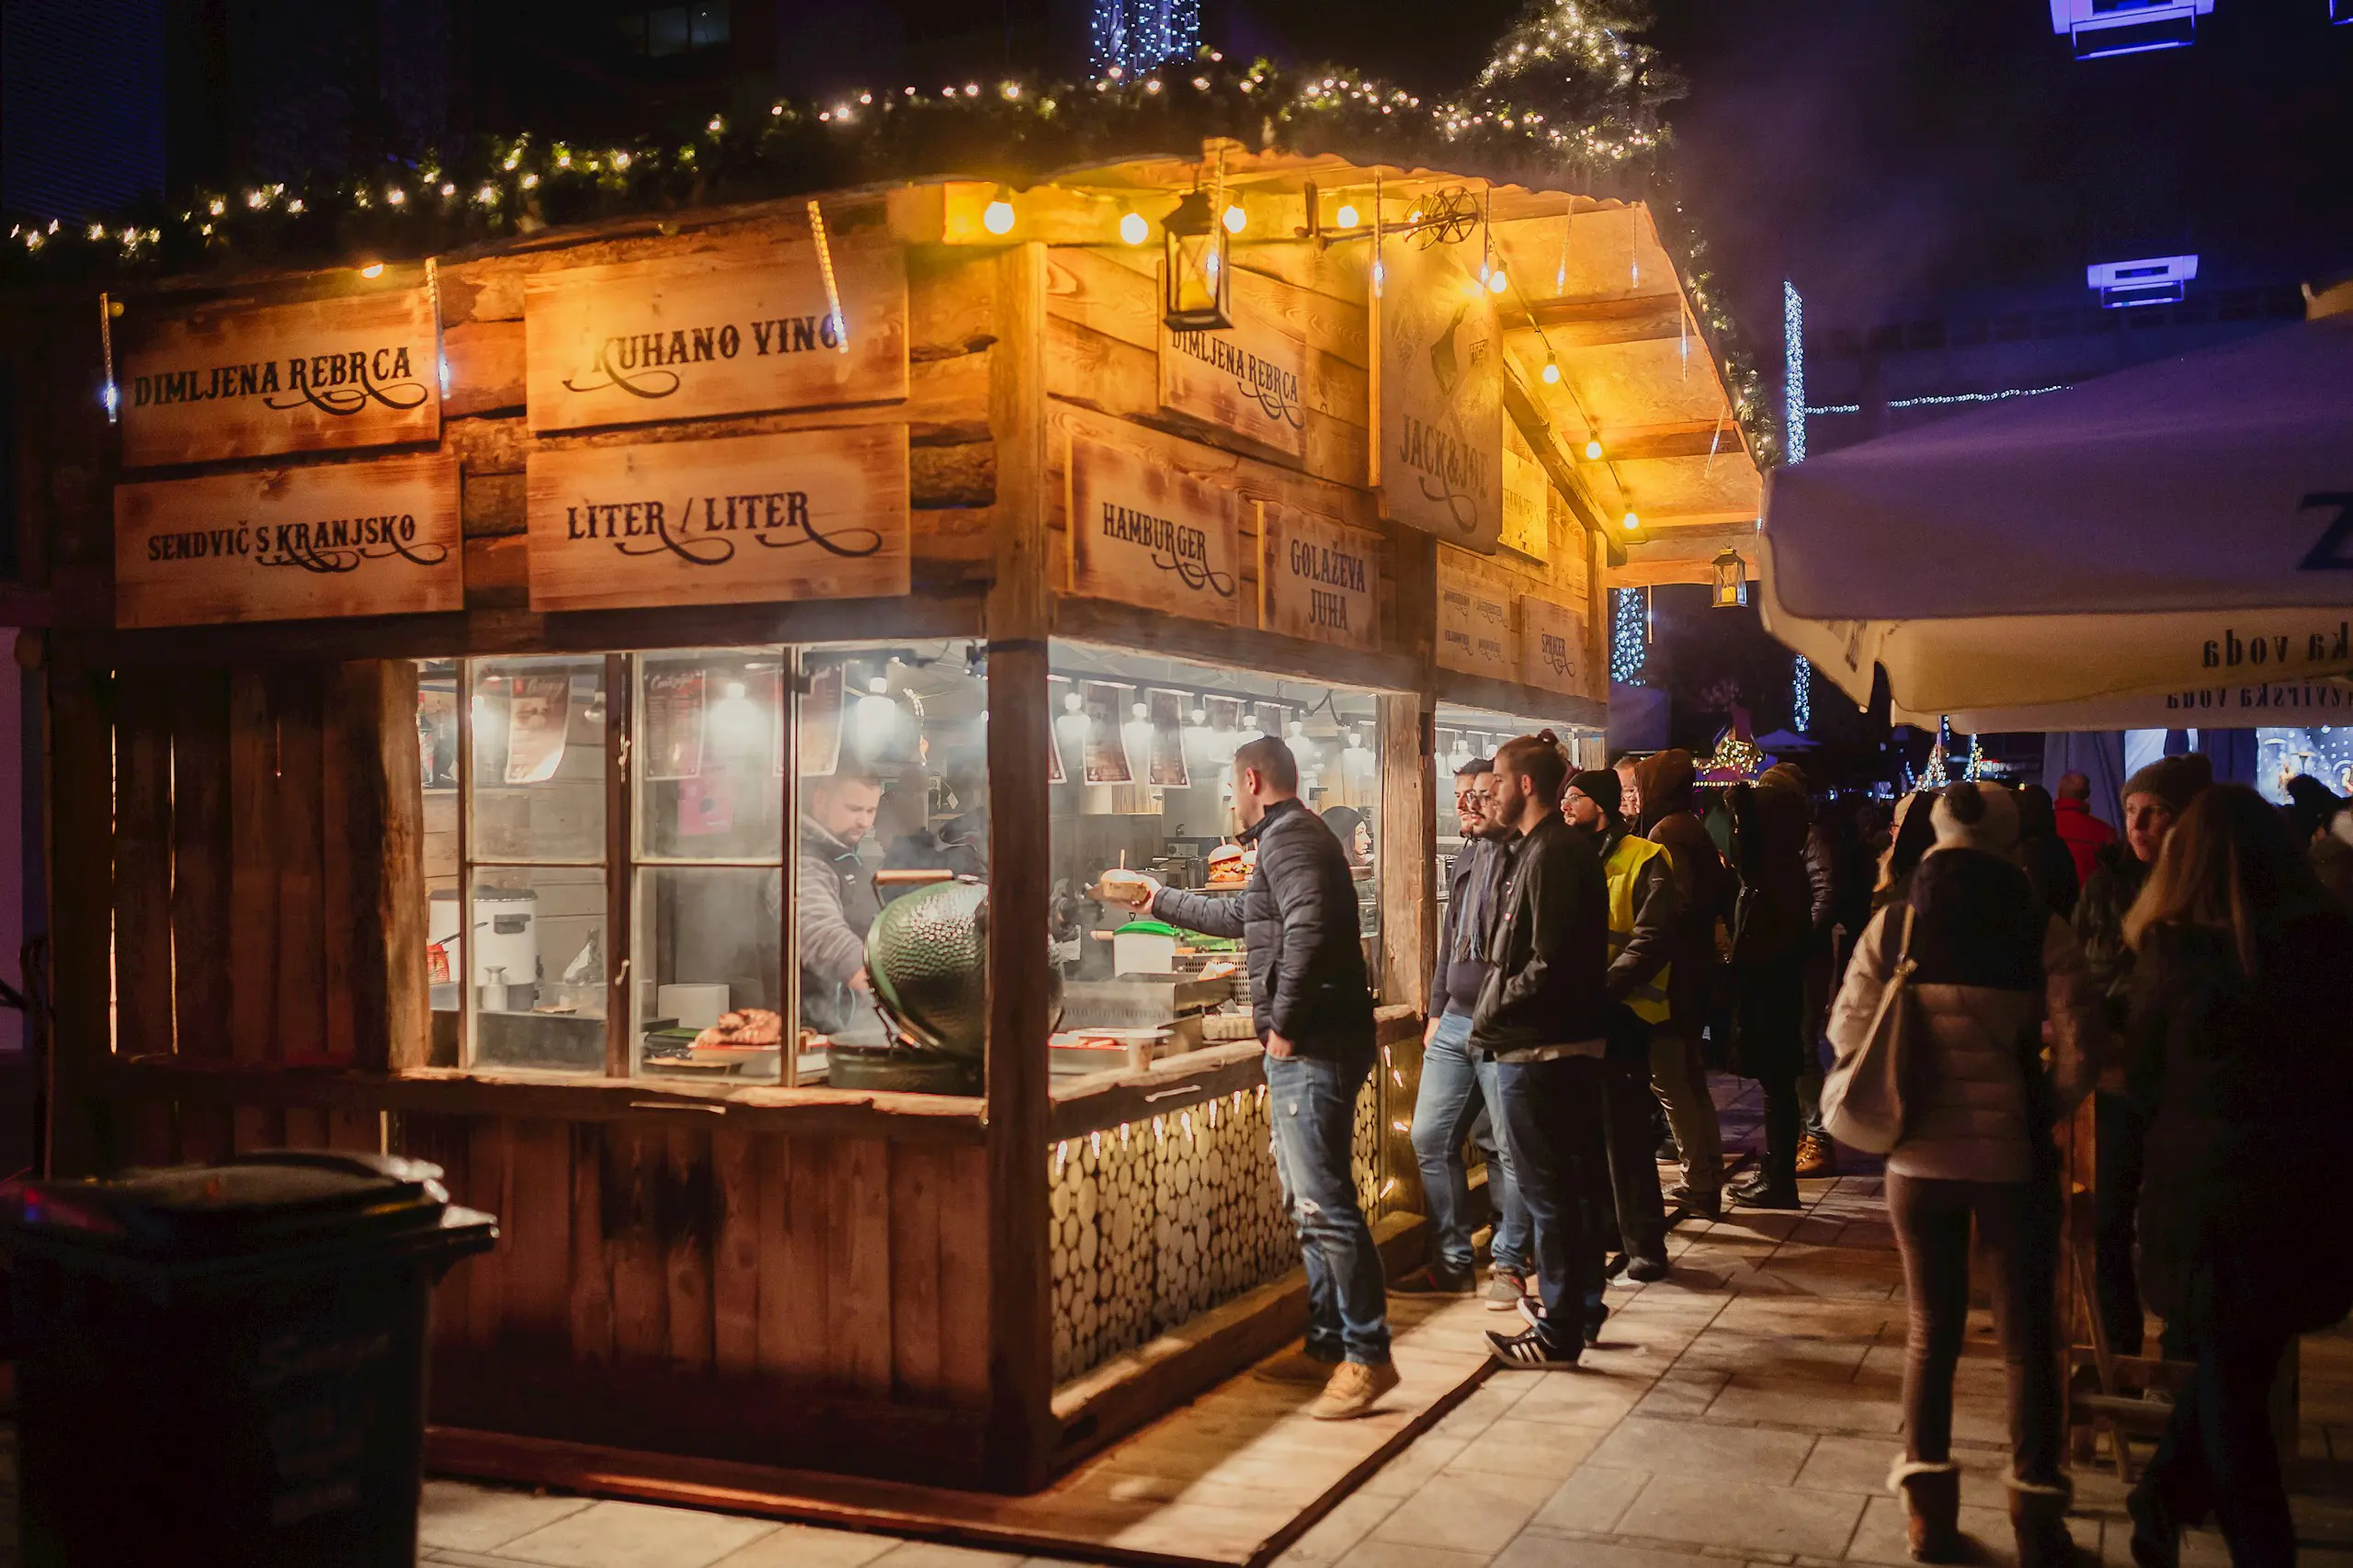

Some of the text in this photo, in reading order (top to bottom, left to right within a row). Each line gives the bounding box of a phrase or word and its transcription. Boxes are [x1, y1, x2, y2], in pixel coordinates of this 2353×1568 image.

[133, 347, 428, 416] DIMLJENA REBRCA
[563, 313, 843, 399] KUHANO VINO
[1172, 331, 1305, 430] DIMLJENA REBRCA
[147, 519, 250, 562] SENDVIČ
[255, 514, 449, 574] KRANJSKO
[566, 500, 735, 566] LITER
[703, 491, 883, 558] LITER
[1102, 502, 1235, 597] HAMBURGER
[1290, 539, 1367, 594] GOLAŽEVA
[1308, 589, 1348, 631] JUHA
